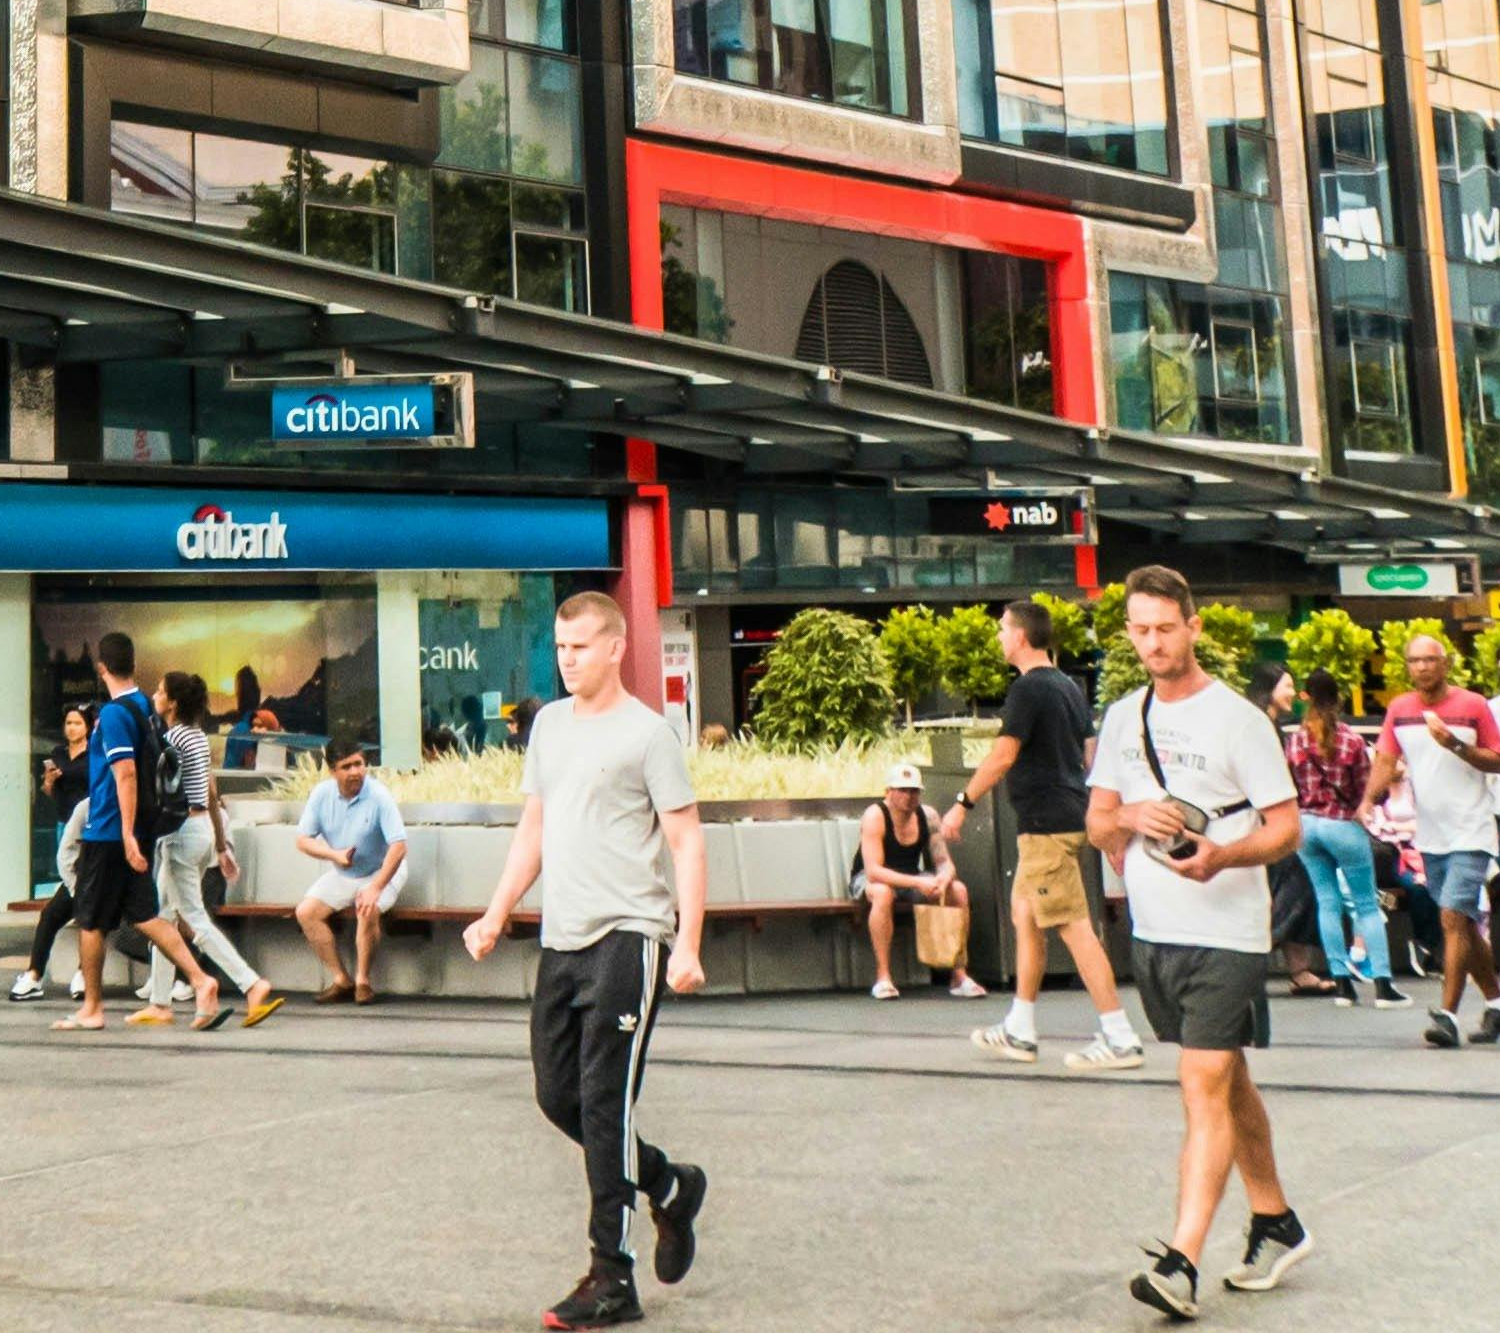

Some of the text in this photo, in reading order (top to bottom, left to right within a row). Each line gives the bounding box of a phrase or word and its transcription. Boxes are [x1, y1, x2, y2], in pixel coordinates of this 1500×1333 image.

[286, 398, 420, 432] citibank
[1013, 501, 1058, 526] nab
[176, 511, 289, 560] citibank
